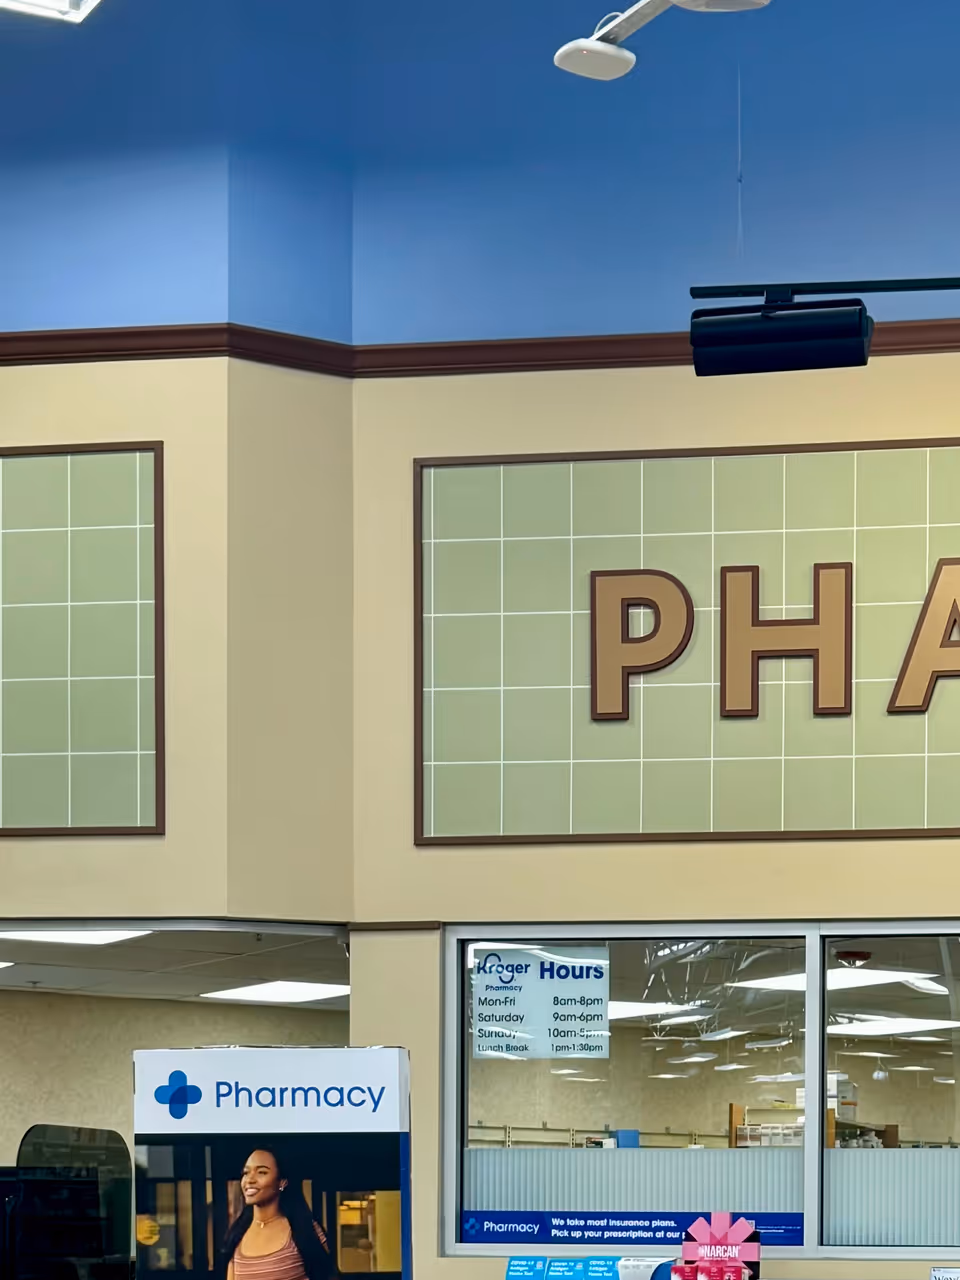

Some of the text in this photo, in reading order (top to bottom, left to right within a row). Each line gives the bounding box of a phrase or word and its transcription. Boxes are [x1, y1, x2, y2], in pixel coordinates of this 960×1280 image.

[477, 953, 604, 984] Kroger Hours
[478, 996, 603, 1007] Mon-Fri 8am-8pm
[478, 1012, 603, 1023] Saturday 9am-6pm
[477, 1028, 603, 1039] Sunday 10am-5pm
[478, 1043, 603, 1053] Lunch Break 1pm-1:30pm
[215, 1081, 386, 1113] Pharmacy
[483, 1221, 540, 1235] Pharmacy
[551, 1217, 678, 1228] We take most insurance plans.
[552, 1228, 568, 1238] Pick
[570, 1230, 582, 1238] up
[584, 1230, 602, 1238] your
[604, 1230, 654, 1240] prescription
[656, 1230, 664, 1238] at
[704, 1245, 739, 1257] NARCAN
